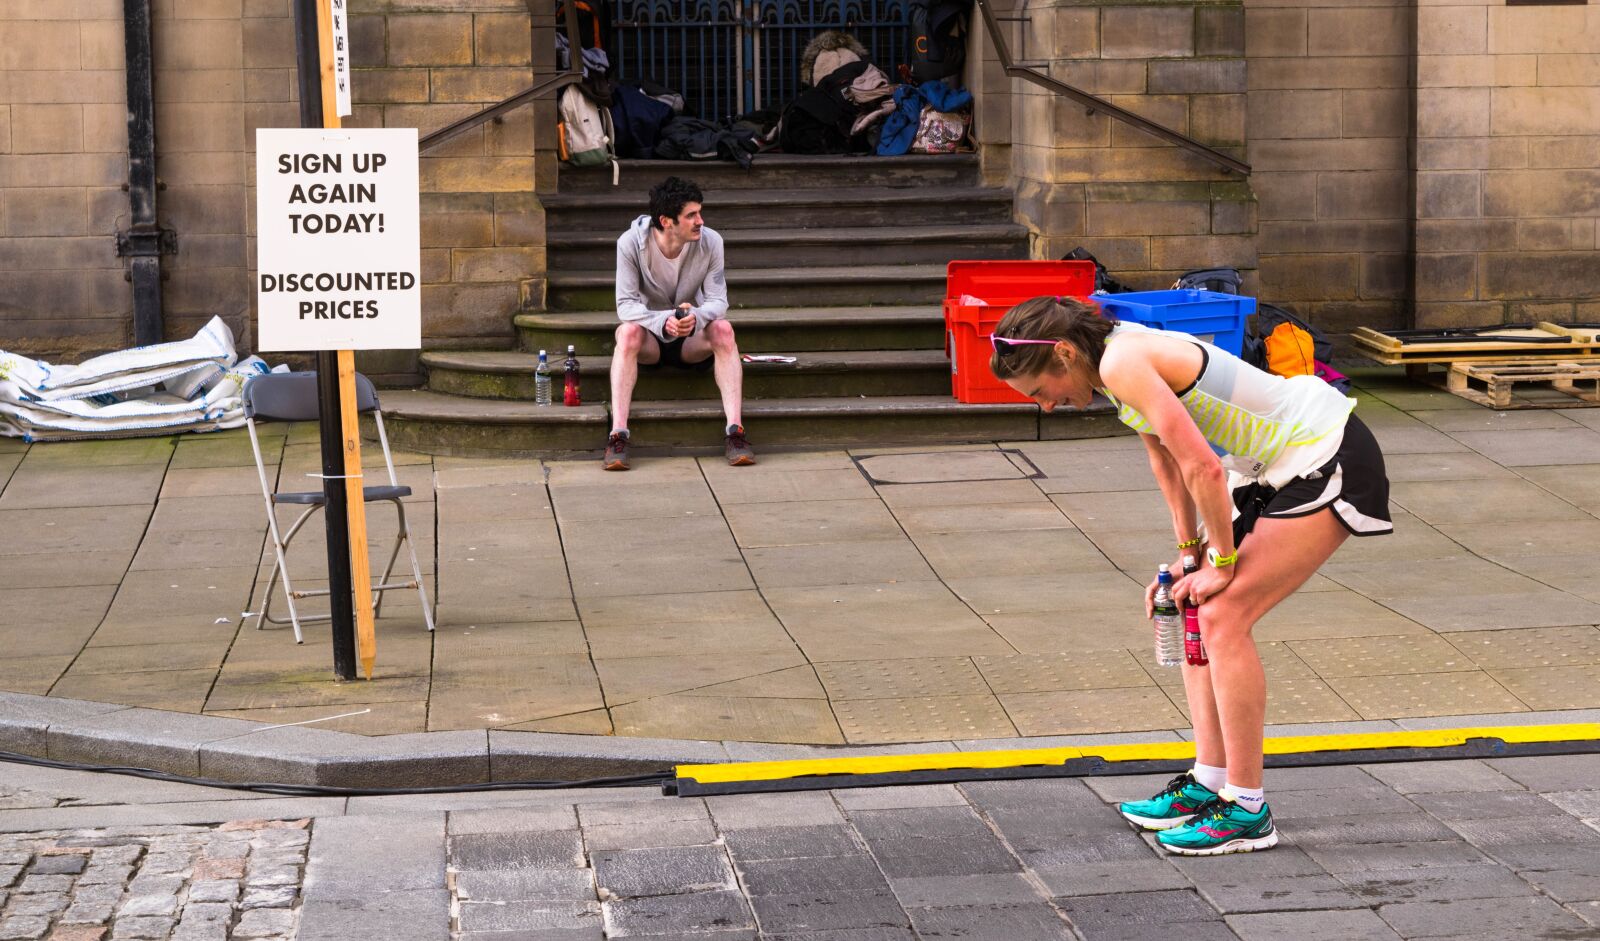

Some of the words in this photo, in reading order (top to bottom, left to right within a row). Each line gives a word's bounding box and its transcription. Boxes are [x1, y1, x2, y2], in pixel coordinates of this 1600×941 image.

[278, 153, 342, 174] SIGN
[352, 153, 387, 174] UP
[288, 183, 376, 204] AGAIN
[288, 213, 385, 234] TODAY!
[261, 271, 415, 293] DISCOUNTED
[299, 300, 379, 320] PRICES
